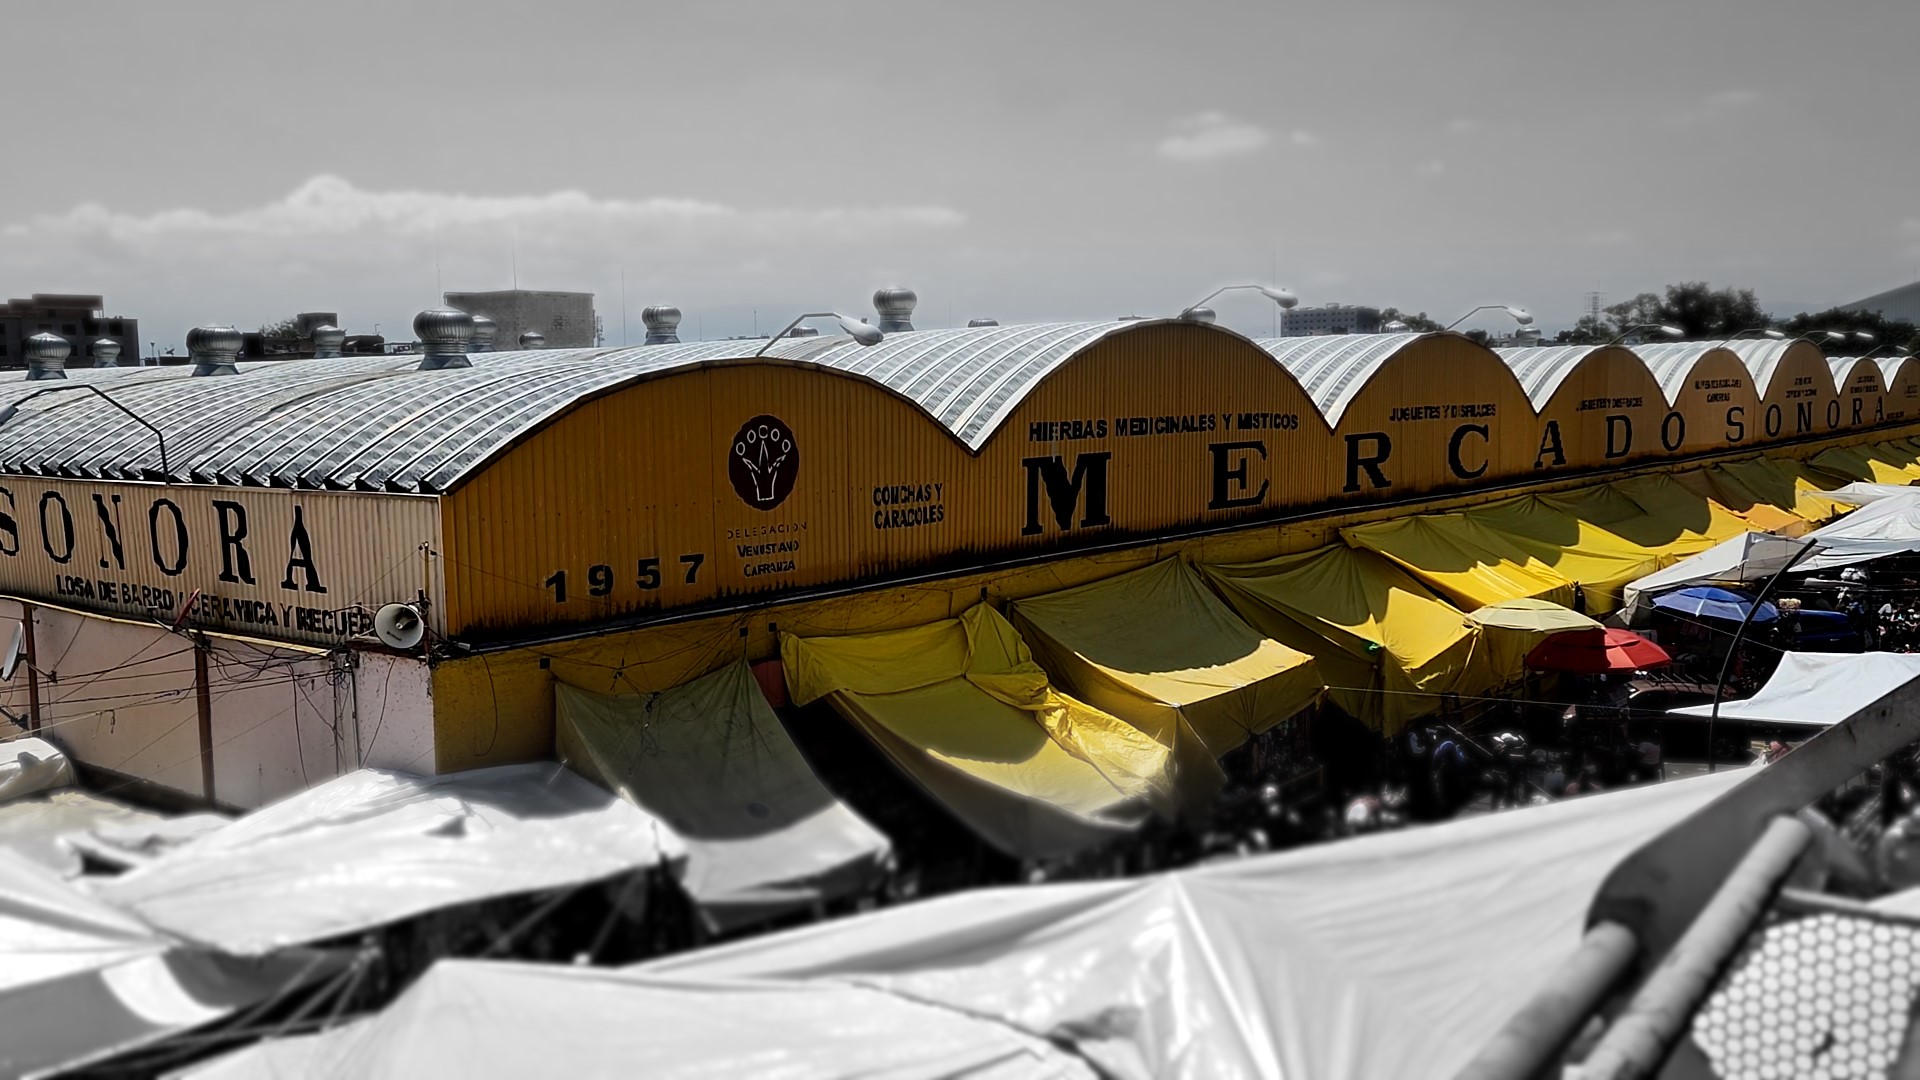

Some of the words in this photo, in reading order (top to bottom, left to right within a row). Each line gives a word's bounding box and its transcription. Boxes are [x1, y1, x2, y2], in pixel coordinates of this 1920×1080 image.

[1029, 419, 1107, 441] HIERBAS
[1115, 411, 1216, 437] MEDICINALES
[1222, 413, 1232, 430] Y
[1238, 412, 1298, 431] MISTICOS
[1442, 404, 1450, 418] Y
[1021, 411, 1685, 537] MERCADO
[1726, 395, 1885, 443] SONORA
[873, 484, 931, 506] CONCHAS
[934, 483, 942, 501] Y
[727, 522, 807, 539] DELEGACION
[874, 504, 943, 529] CARACOLES
[0, 486, 327, 594] SONORA
[545, 553, 704, 603] 1957
[56, 574, 95, 600] LOSA
[97, 580, 118, 603] DE
[121, 583, 174, 611] BARRO
[280, 602, 292, 628] Y
